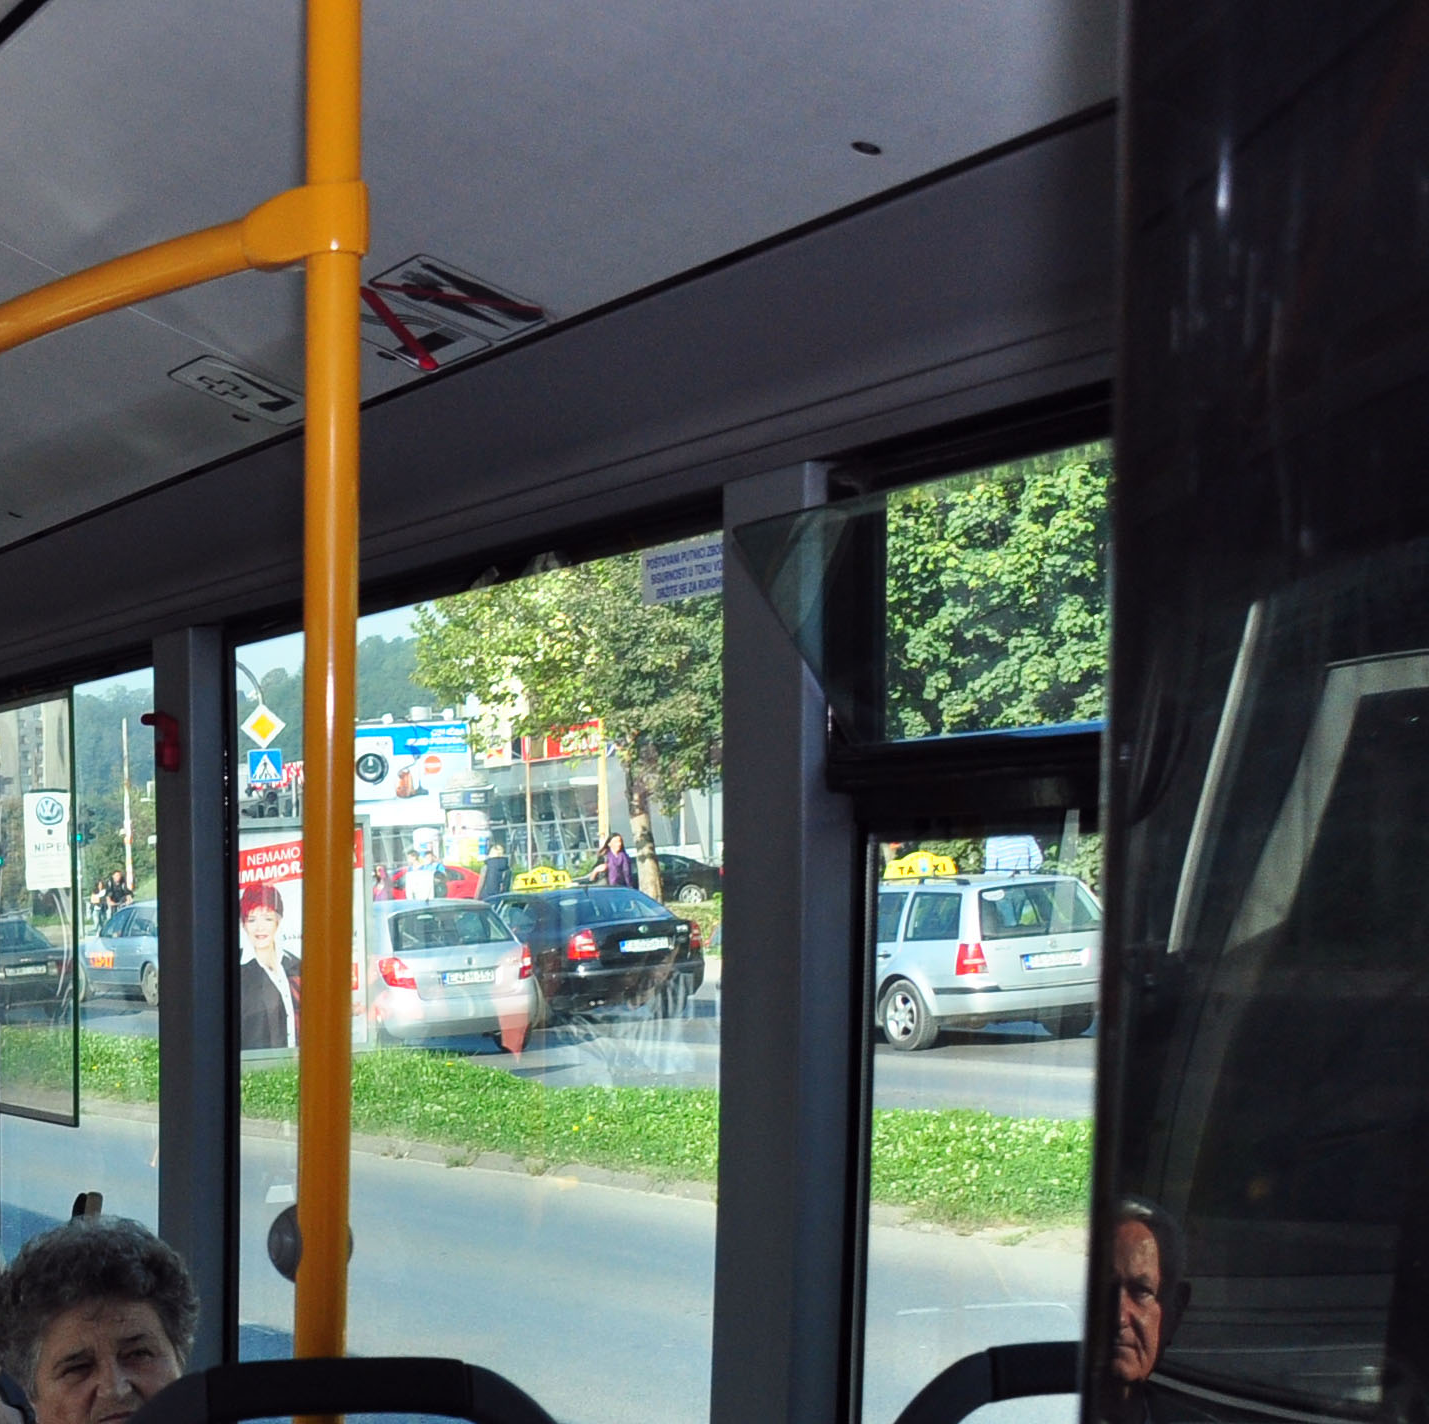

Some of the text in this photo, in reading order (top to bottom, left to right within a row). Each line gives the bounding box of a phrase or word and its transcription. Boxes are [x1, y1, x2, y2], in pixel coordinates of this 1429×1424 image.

[681, 547, 705, 562] PUTNICI
[706, 543, 723, 558] ZBO
[679, 581, 687, 595] SE
[688, 579, 697, 593] ZA
[698, 575, 723, 591] RUKOH
[246, 846, 302, 867] NEMAMO
